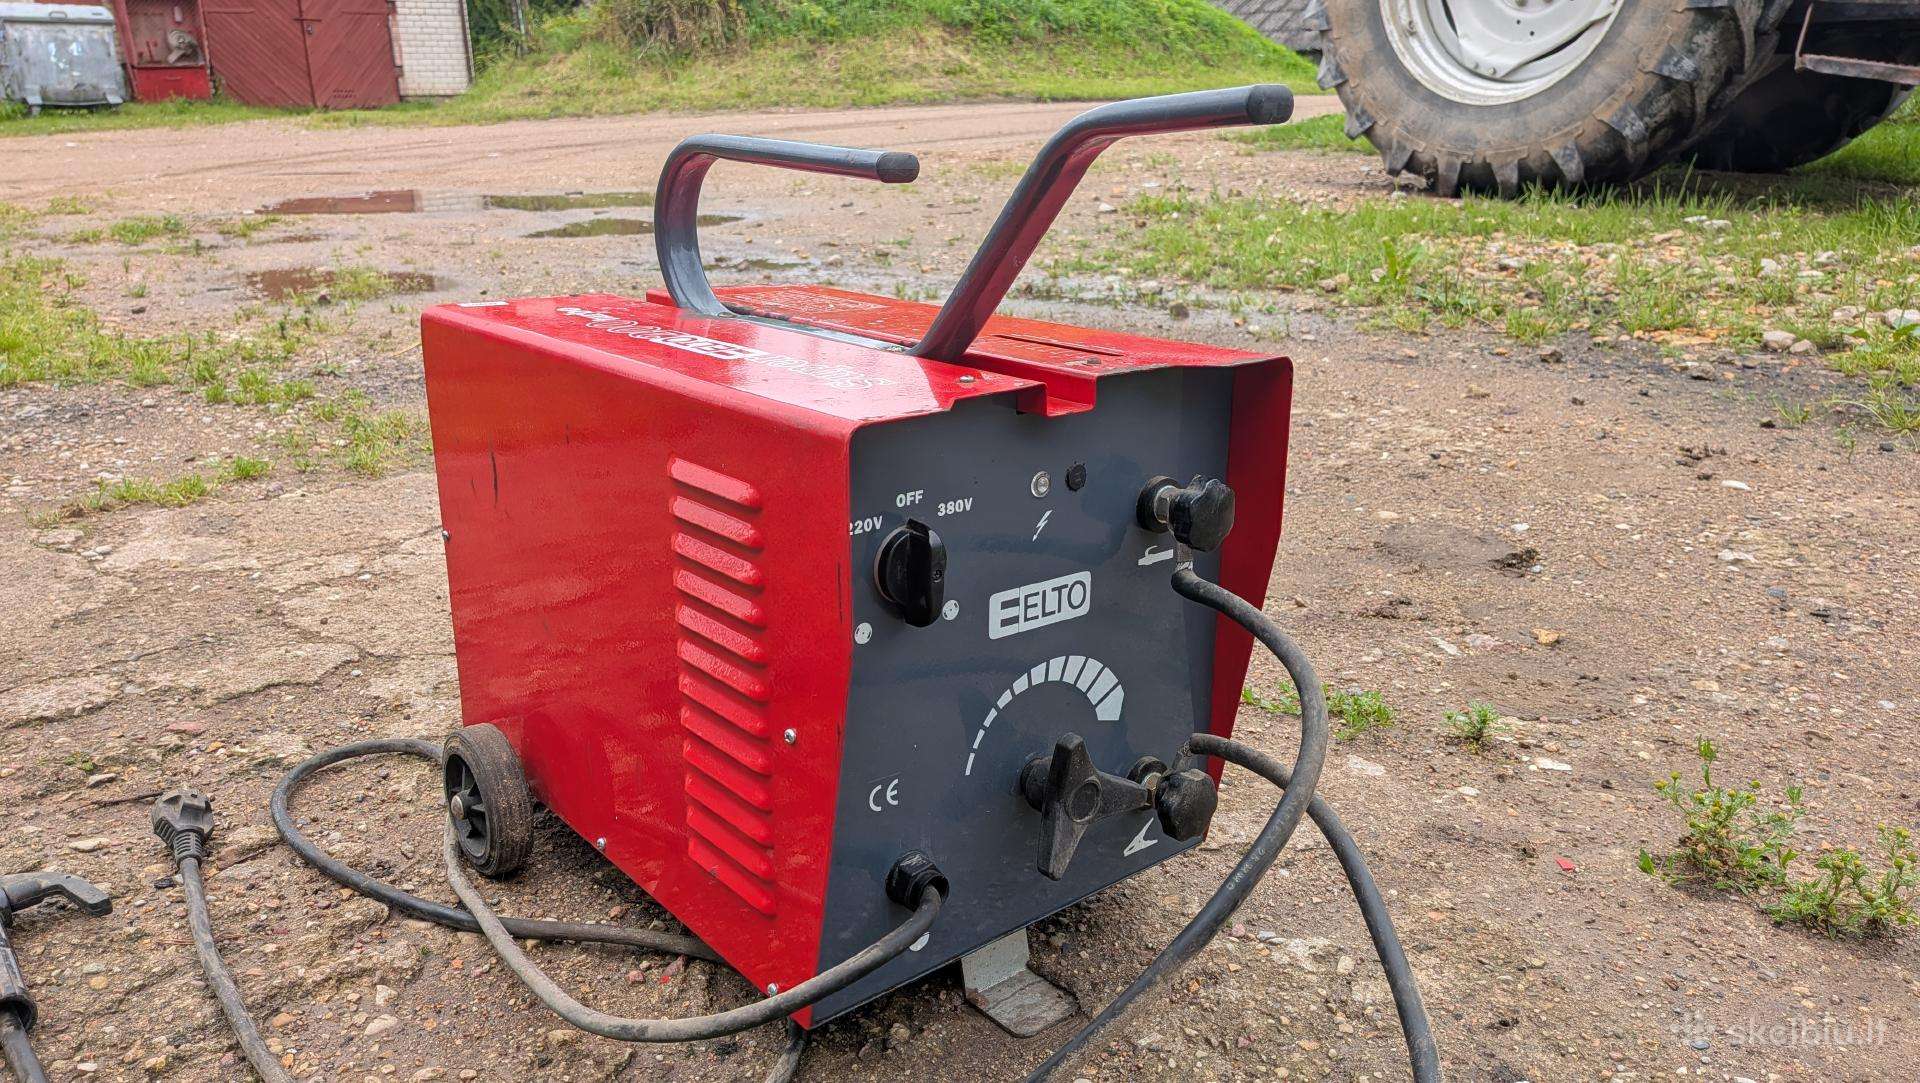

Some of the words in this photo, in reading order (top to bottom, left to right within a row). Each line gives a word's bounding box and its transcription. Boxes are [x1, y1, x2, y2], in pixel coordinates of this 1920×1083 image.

[896, 489, 924, 508] OFF
[937, 497, 973, 517] 380V
[869, 778, 899, 812] CE
